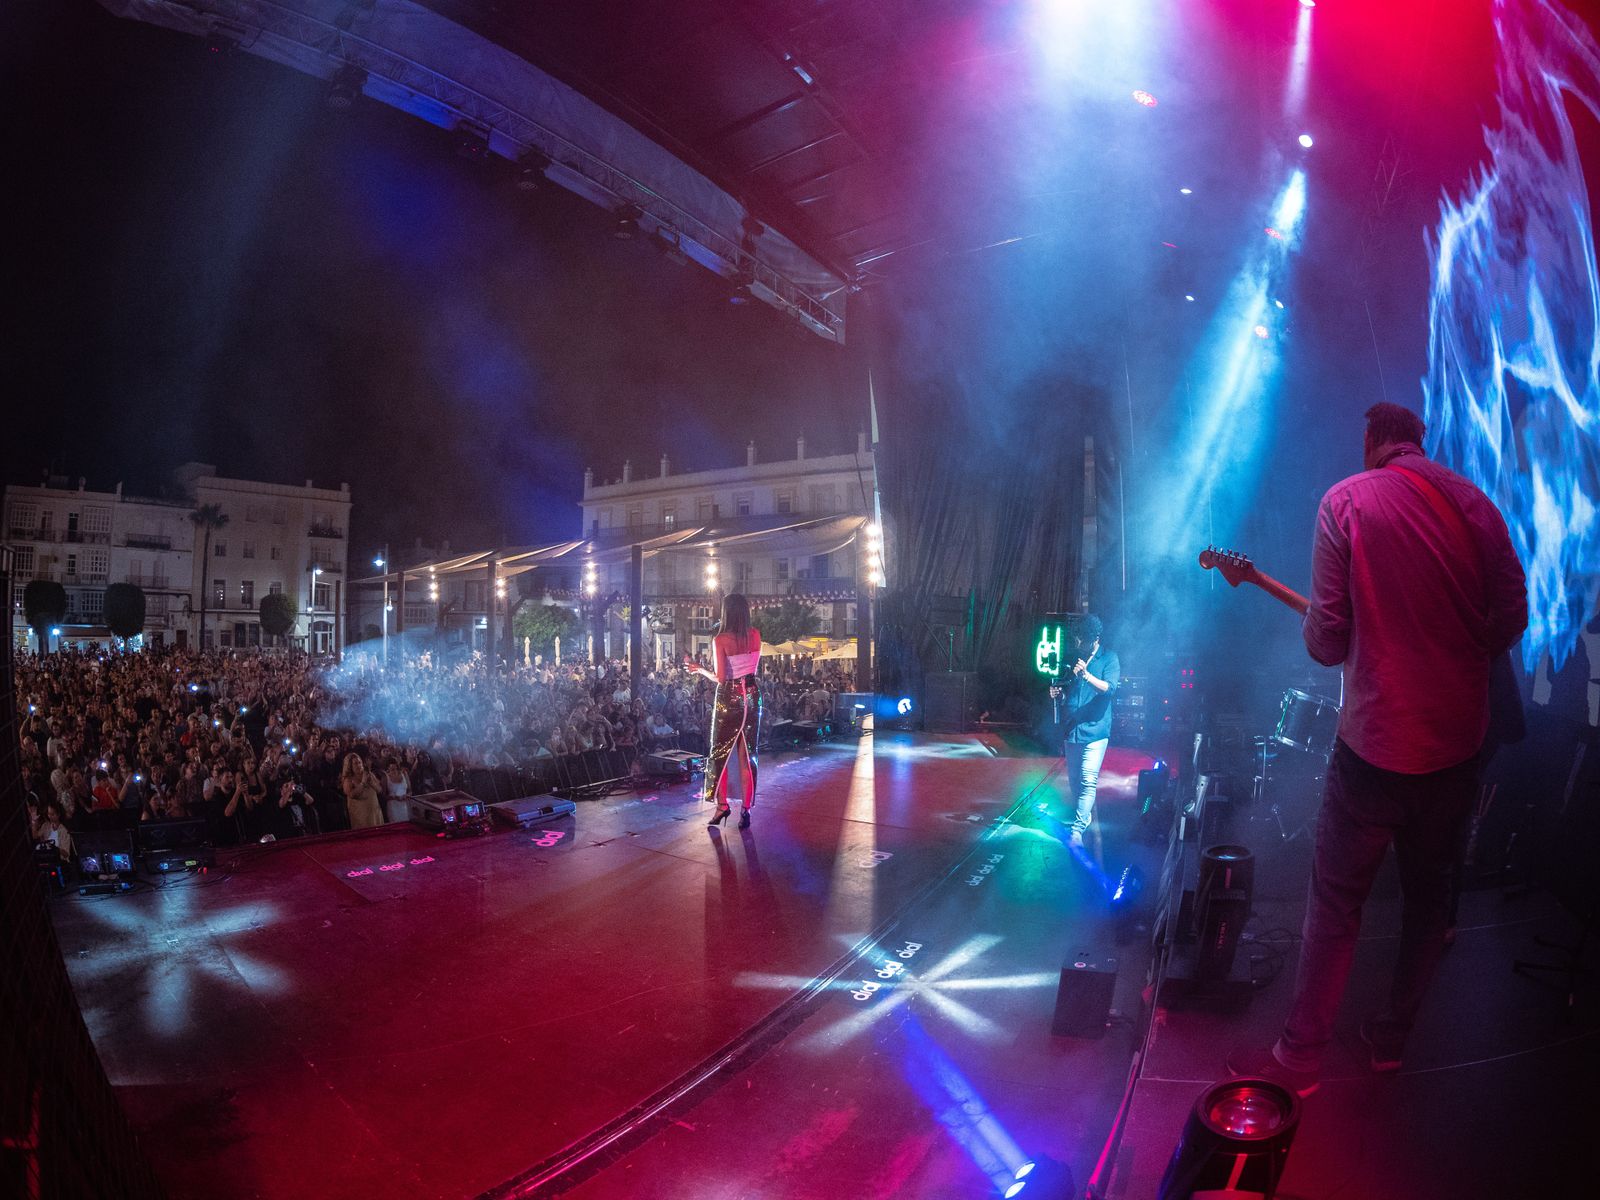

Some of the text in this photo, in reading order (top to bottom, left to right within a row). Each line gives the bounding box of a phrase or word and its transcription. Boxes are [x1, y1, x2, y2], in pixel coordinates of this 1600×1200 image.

[347, 867, 374, 878] dial
[410, 855, 435, 865] dial
[850, 979, 882, 1001] dial
[874, 959, 904, 979] dial
[896, 941, 923, 959] dial
